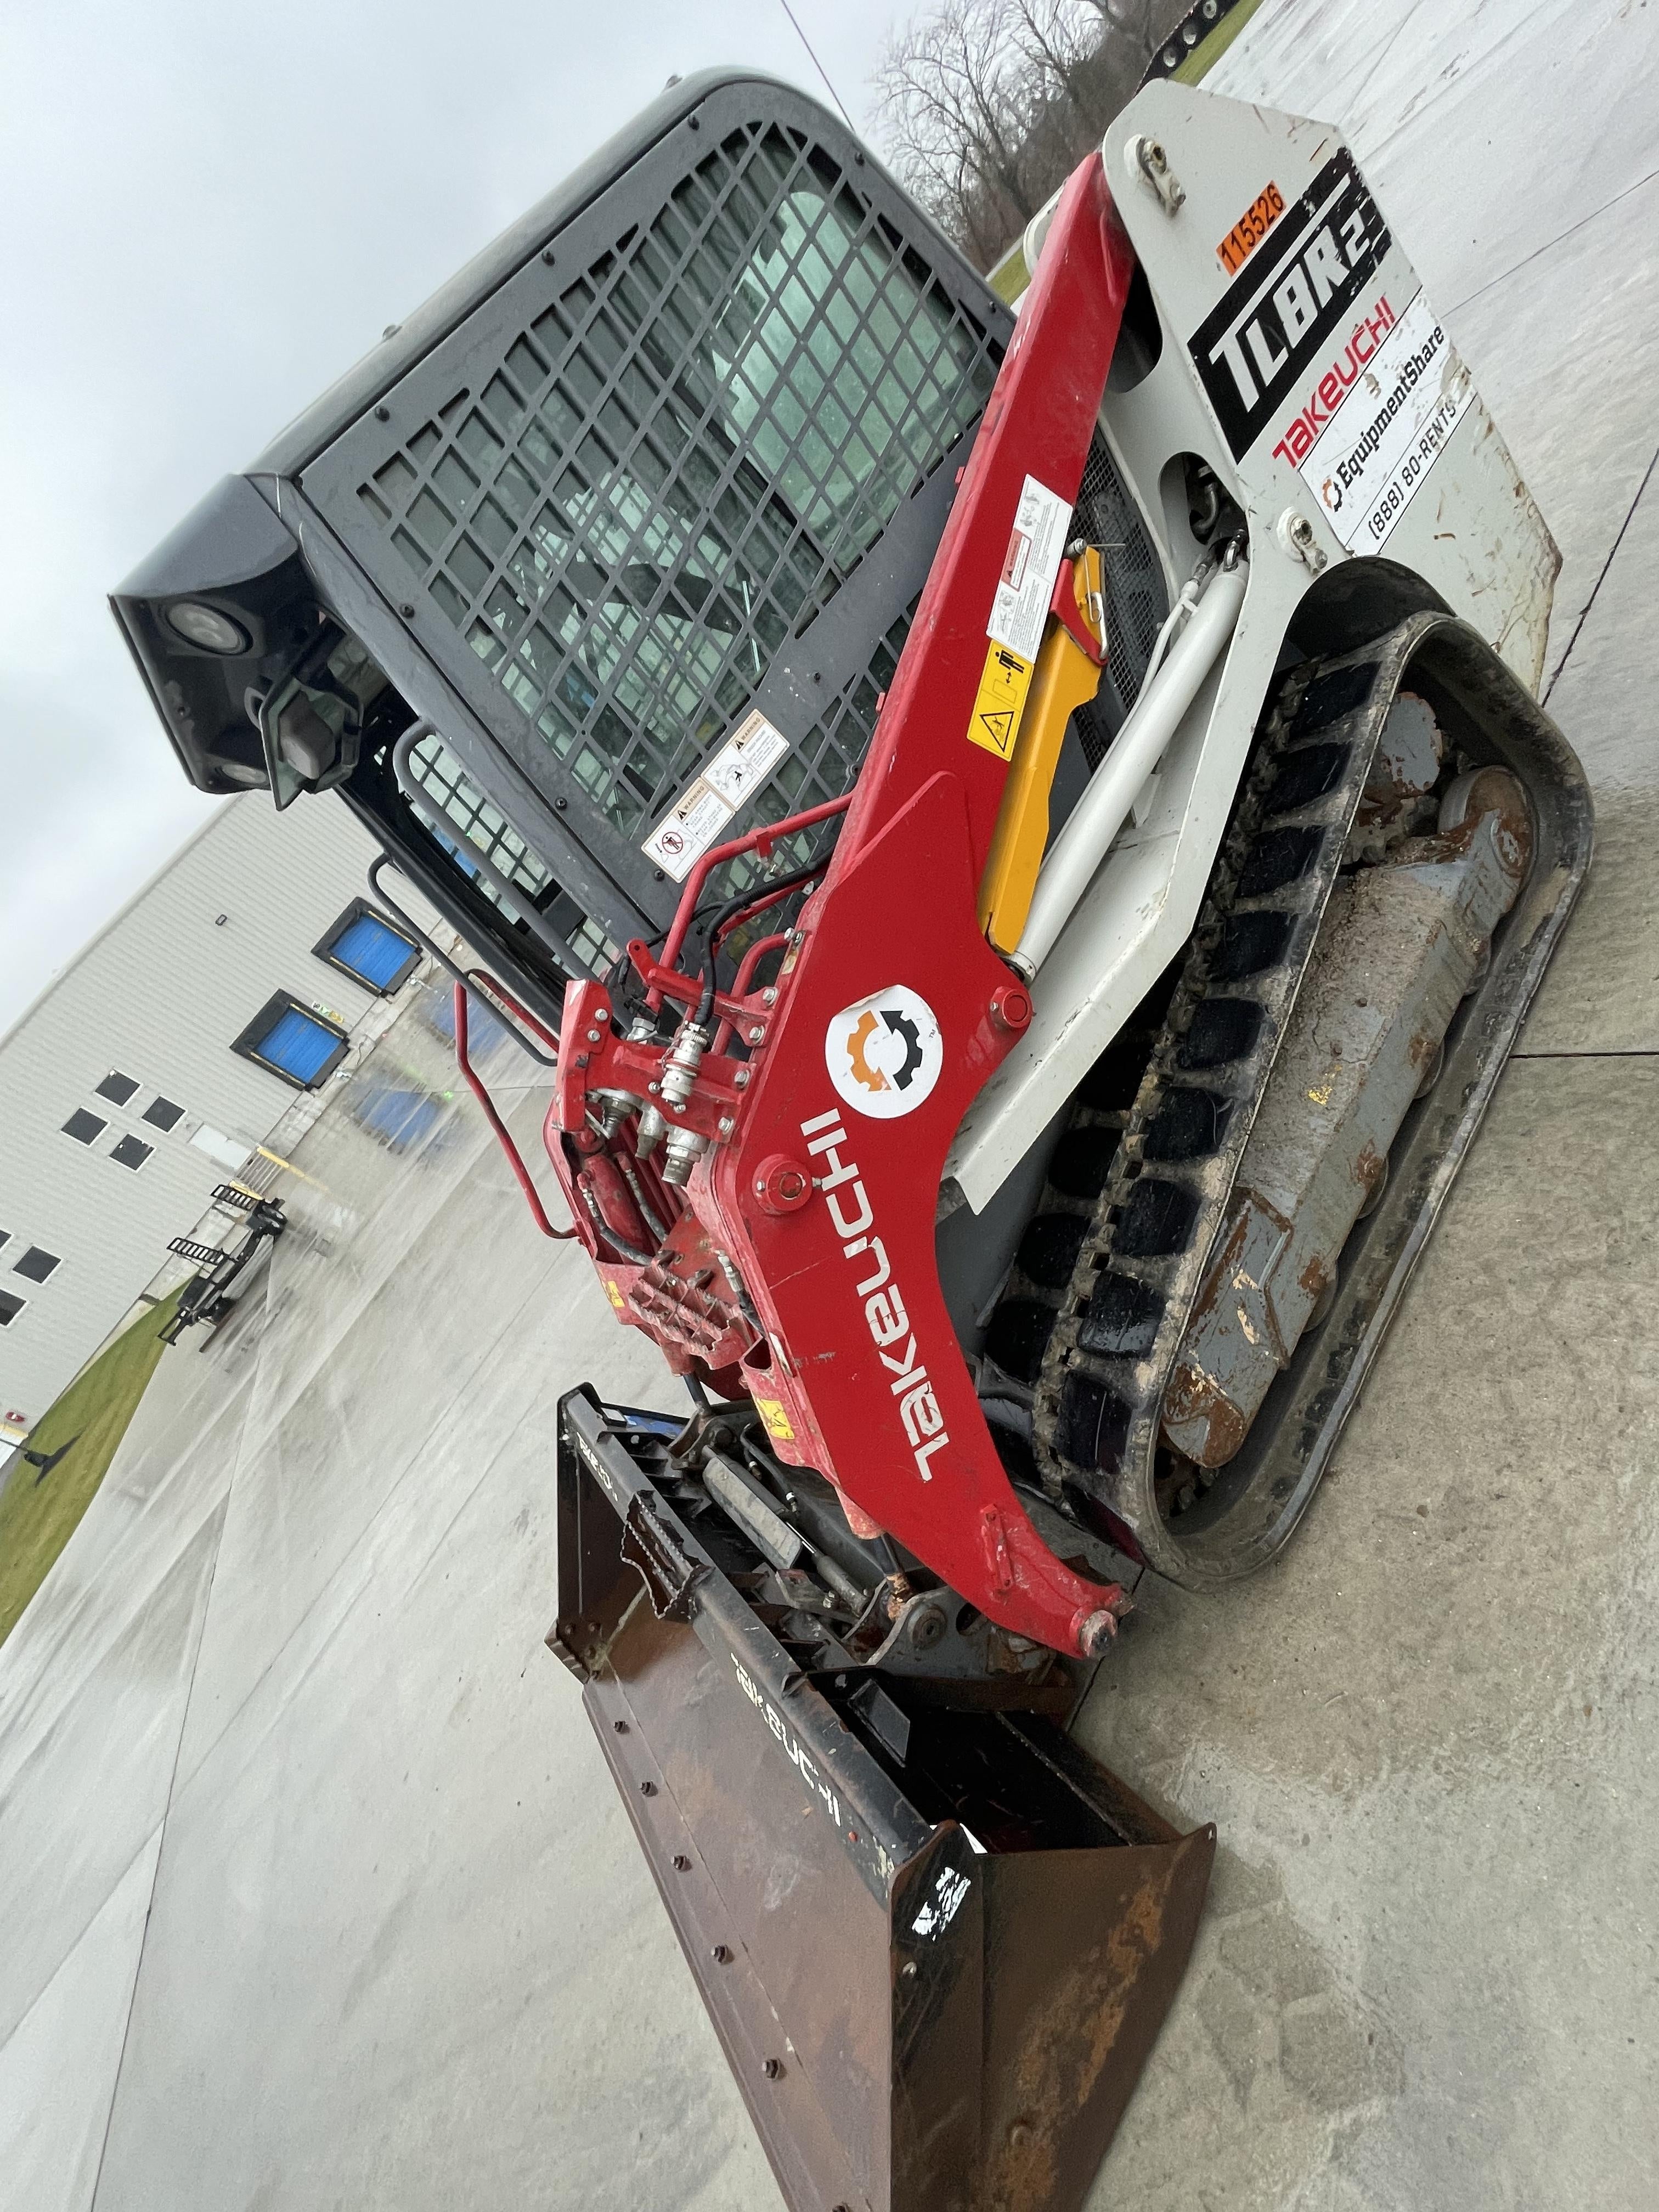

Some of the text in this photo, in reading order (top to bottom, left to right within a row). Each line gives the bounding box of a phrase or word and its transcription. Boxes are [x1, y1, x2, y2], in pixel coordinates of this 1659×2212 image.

[1208, 172, 1370, 413] TL8R2
[1221, 184, 1284, 269] 115526
[1335, 326, 1444, 489] EquipmentShare
[1368, 399, 1457, 540] (888) 80-RENTS
[684, 786, 705, 810] WARNING
[741, 717, 761, 741] WARNING
[800, 1107, 950, 1483] TAKEUCHI
